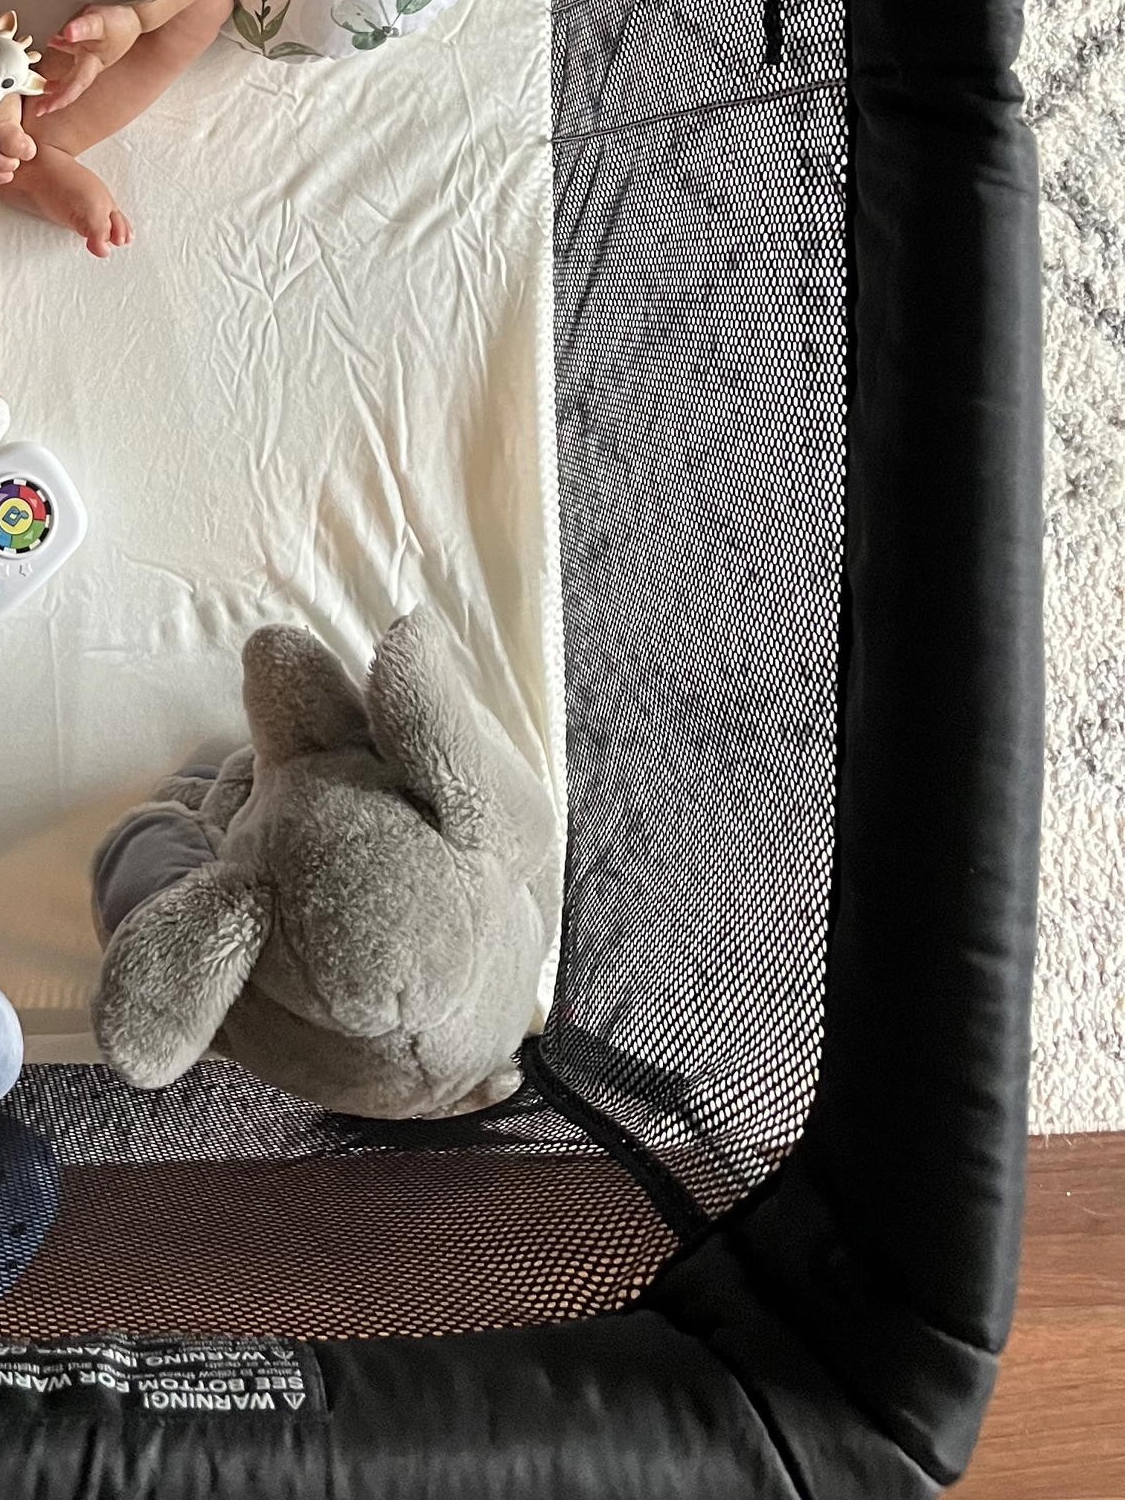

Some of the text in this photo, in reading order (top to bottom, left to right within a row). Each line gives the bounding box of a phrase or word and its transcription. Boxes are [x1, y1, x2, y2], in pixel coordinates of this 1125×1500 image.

[145, 1351, 265, 1366] WARNING
[80, 1371, 130, 1393] FOR
[138, 1378, 245, 1391] BOTTOM
[256, 1376, 304, 1390] SEE
[143, 1391, 275, 1410] WARNING!
